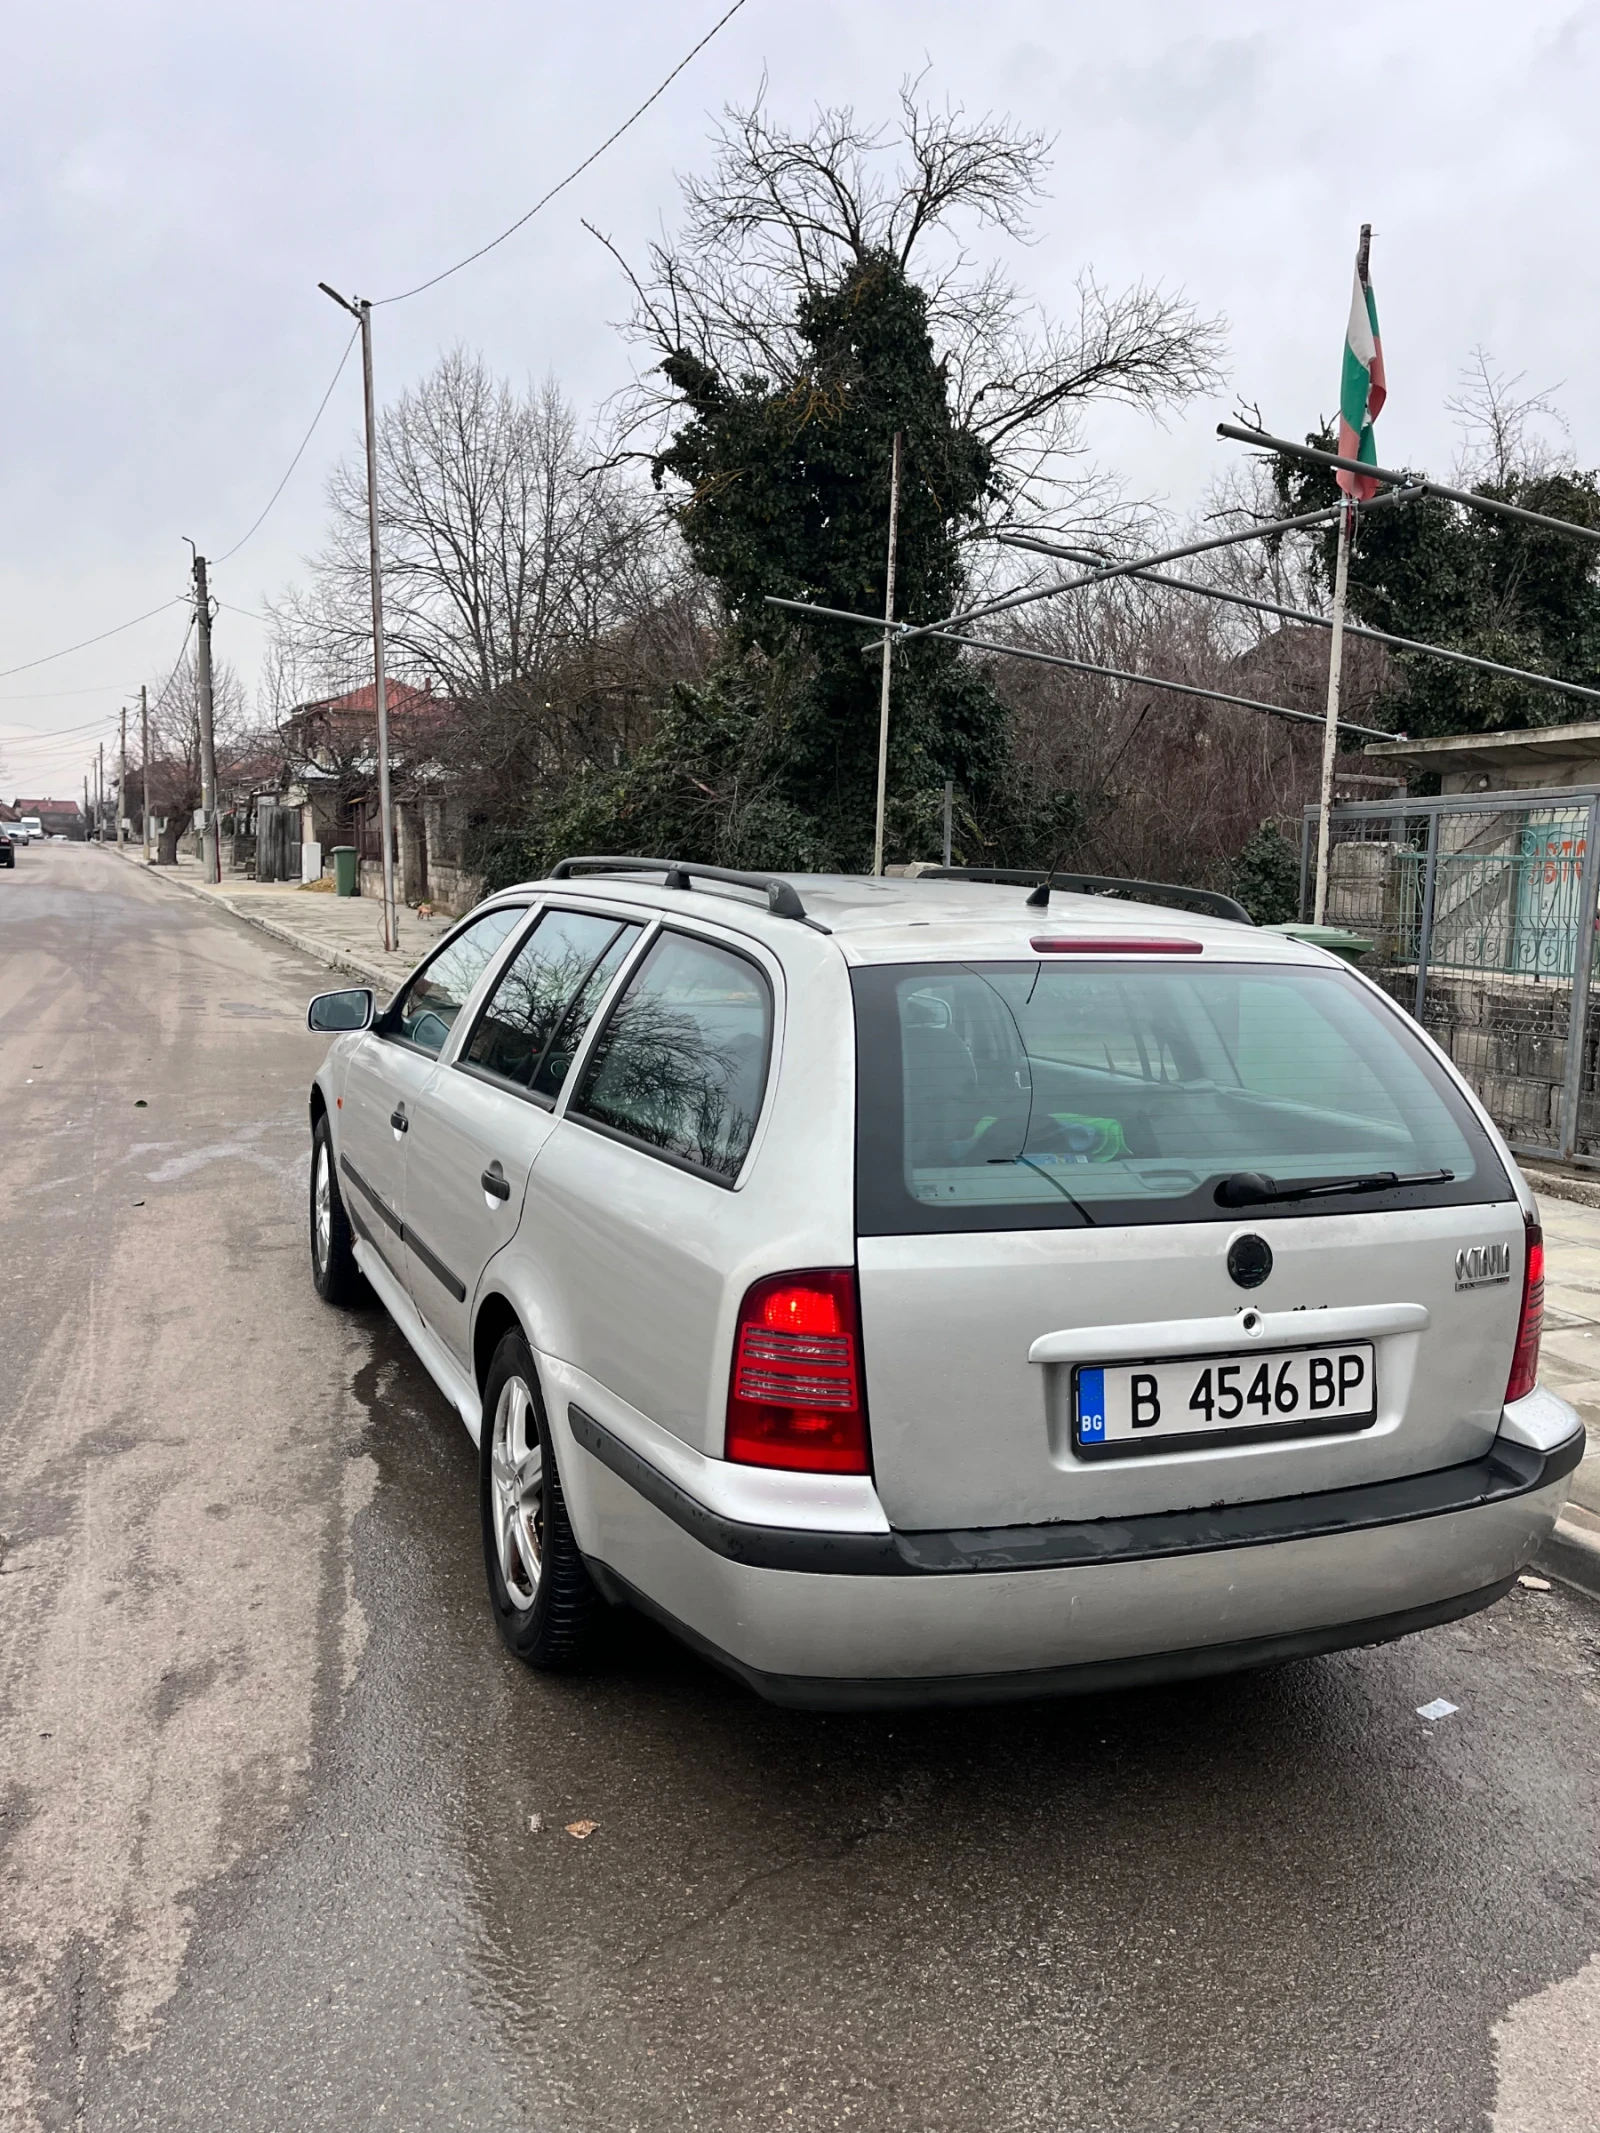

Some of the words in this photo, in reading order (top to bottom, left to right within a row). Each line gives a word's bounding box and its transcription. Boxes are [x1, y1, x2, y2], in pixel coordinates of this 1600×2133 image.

[1455, 1242, 1510, 1280] OCTAVIA
[1131, 1374, 1161, 1429] B
[1188, 1360, 1299, 1422] 4546
[1309, 1354, 1364, 1410] BP
[1081, 1414, 1102, 1432] BG
